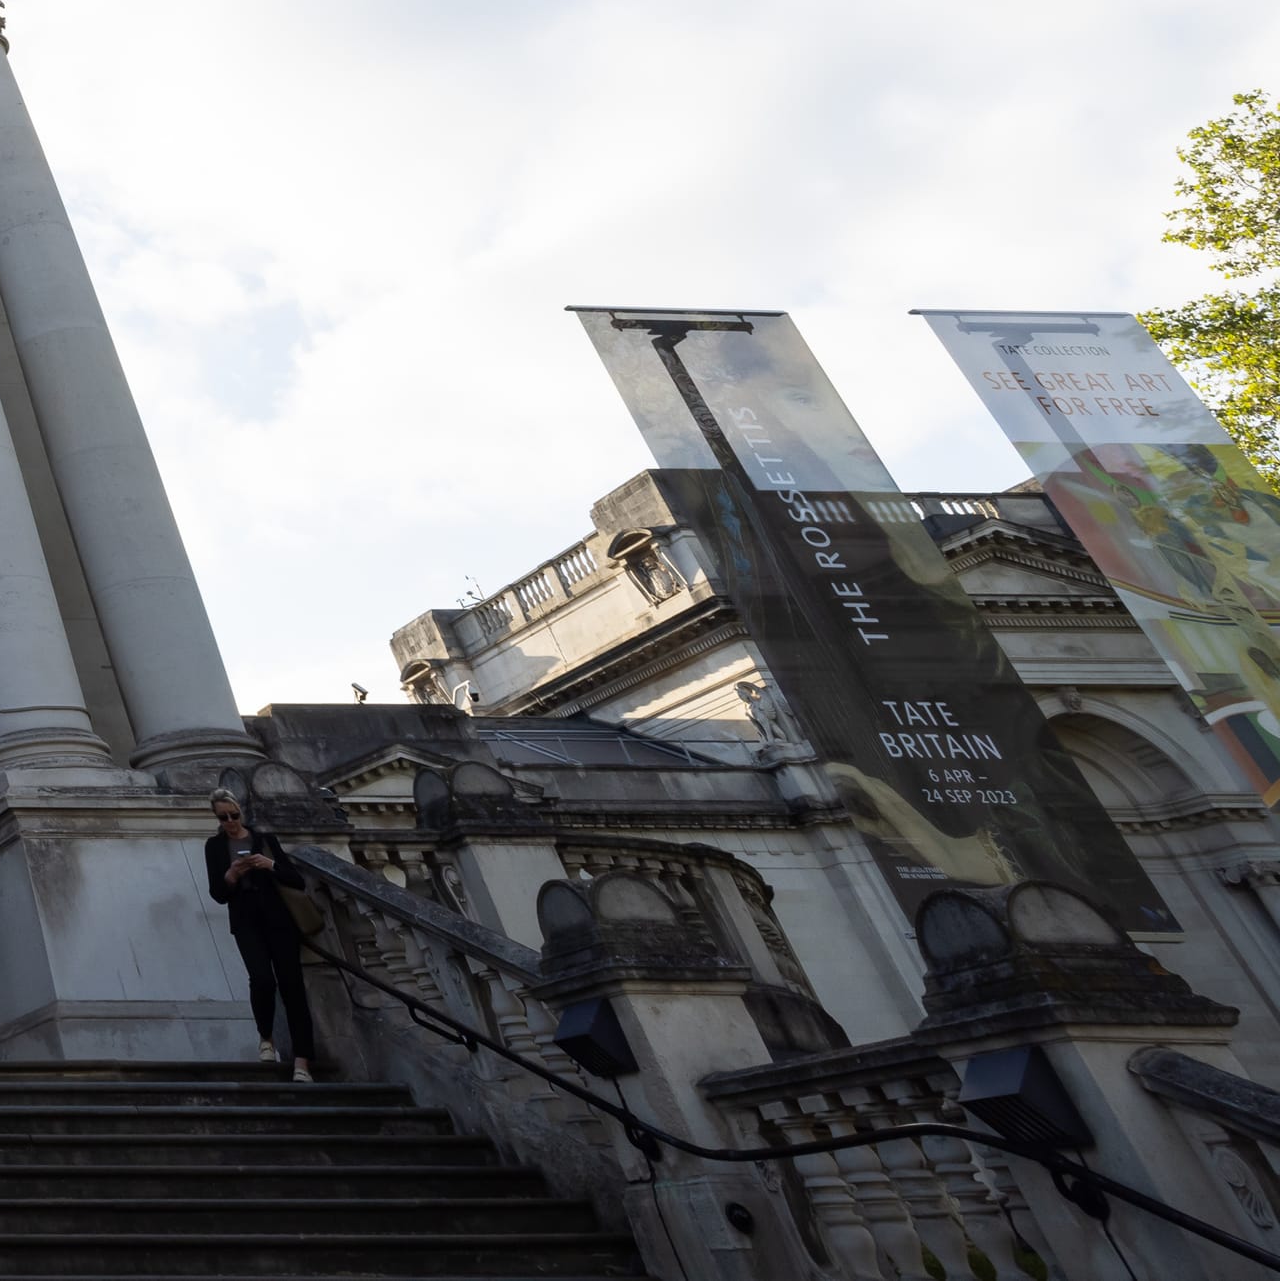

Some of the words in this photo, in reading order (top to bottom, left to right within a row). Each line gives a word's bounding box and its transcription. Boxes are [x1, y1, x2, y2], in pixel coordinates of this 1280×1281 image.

[1000, 345, 1032, 356] TATE
[1033, 345, 1111, 357] COLLECTION
[982, 371, 1032, 391] SEE
[1034, 372, 1117, 392] GREAT
[1123, 373, 1174, 392] ART
[1036, 396, 1096, 416] FOR
[1094, 397, 1160, 417] FREE
[728, 407, 846, 568] ROSSETTIS
[831, 582, 889, 646] THE
[882, 701, 959, 727] TATE
[879, 733, 1002, 759] BRITAIN
[928, 769, 940, 783] 6
[943, 769, 976, 783] APR
[922, 788, 944, 803] 24
[945, 789, 972, 803] SEP
[976, 790, 1017, 804] 2023
